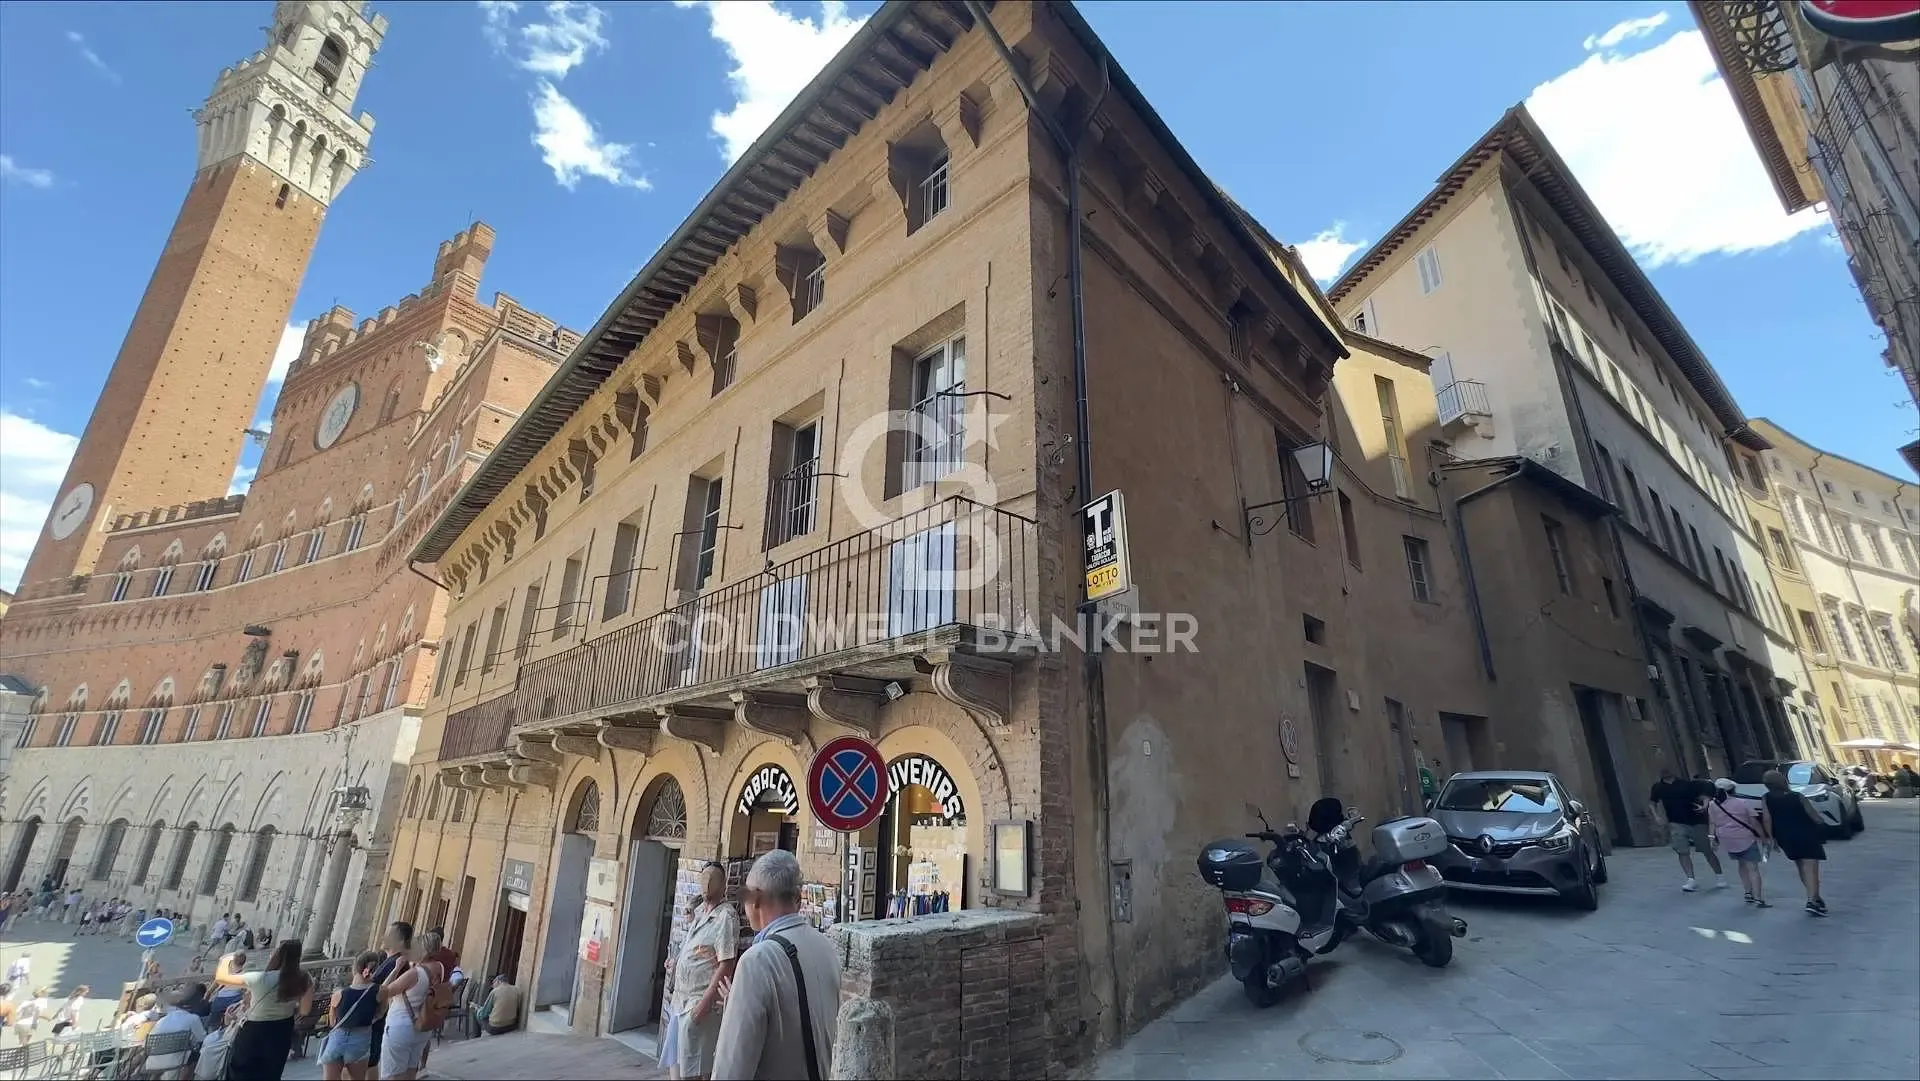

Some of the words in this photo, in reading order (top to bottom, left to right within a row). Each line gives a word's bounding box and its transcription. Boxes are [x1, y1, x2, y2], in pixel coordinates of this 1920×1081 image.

[1087, 500, 1108, 548] T
[1088, 567, 1118, 587] LOTTO
[738, 767, 798, 817] TABACCHI
[880, 758, 961, 819] UVENIRS
